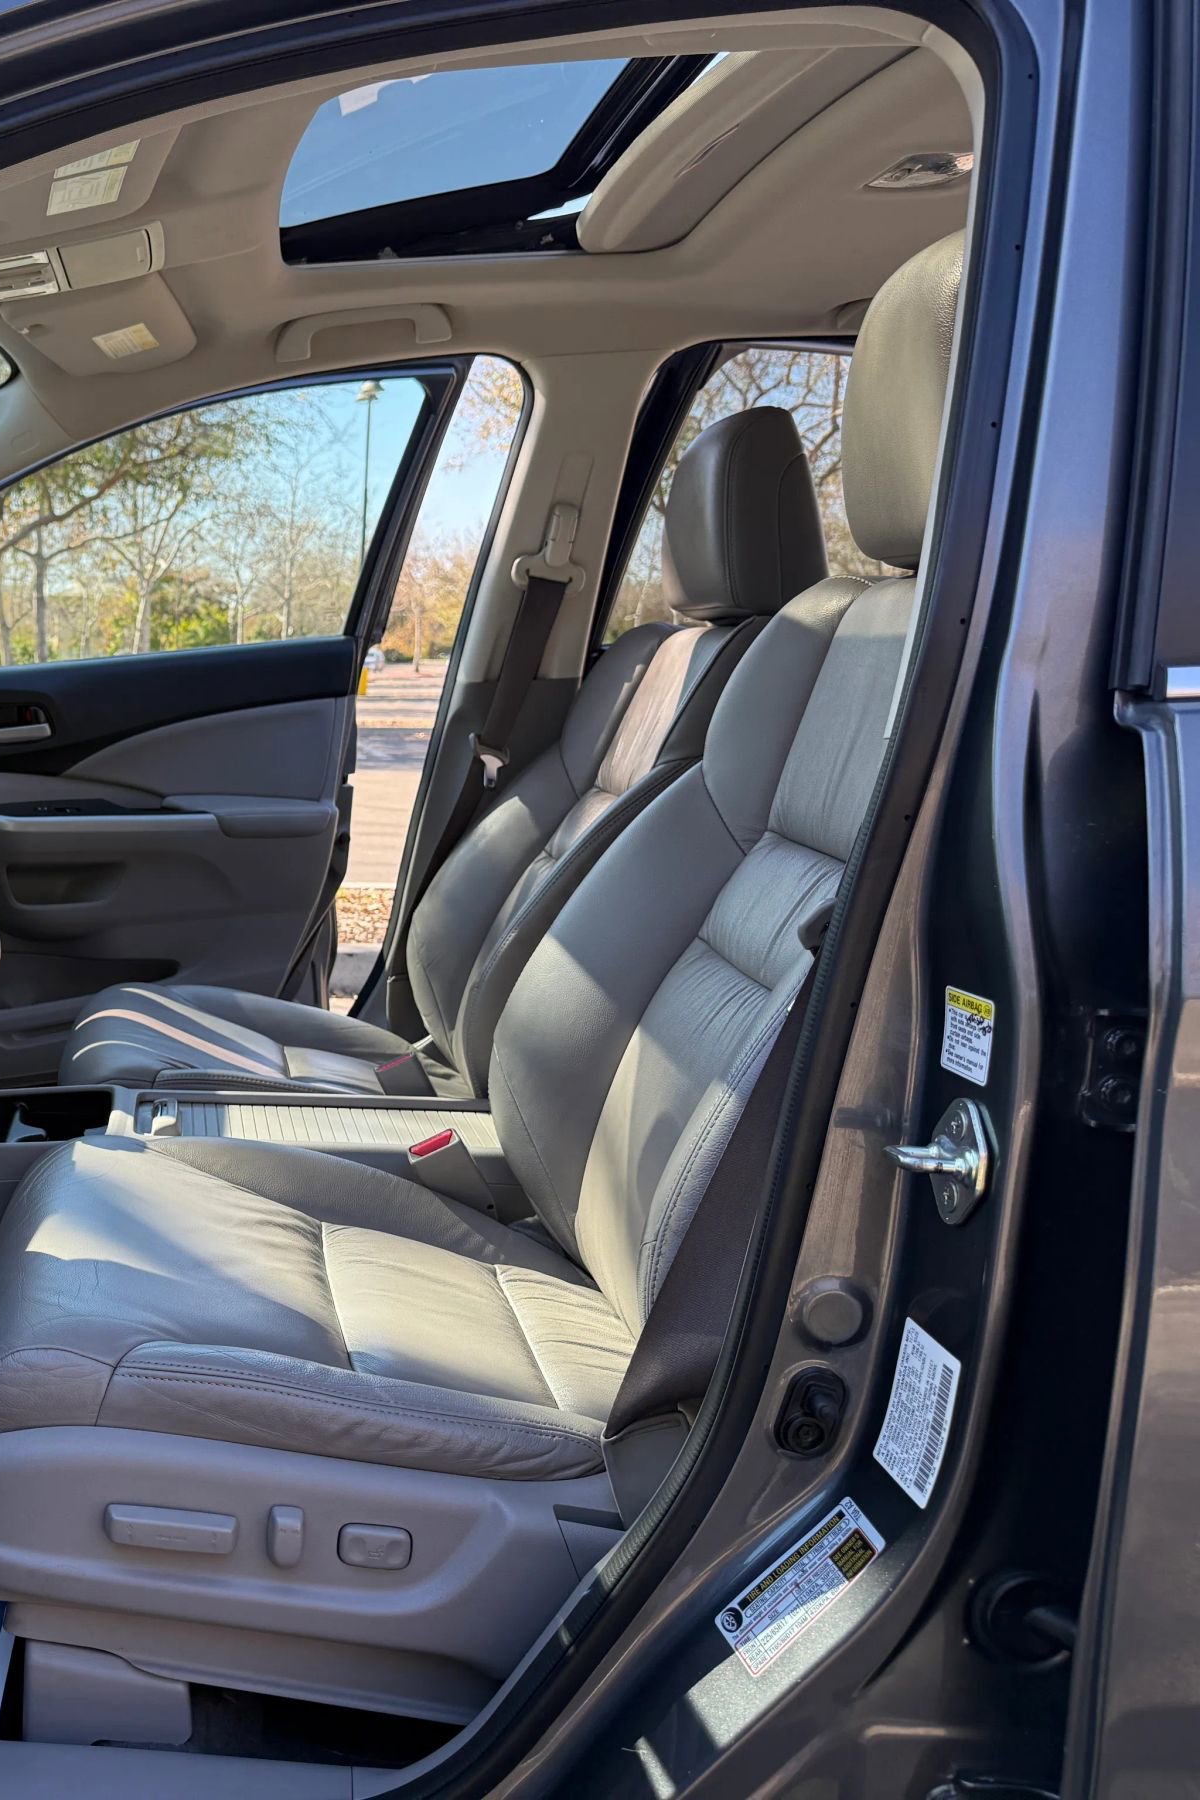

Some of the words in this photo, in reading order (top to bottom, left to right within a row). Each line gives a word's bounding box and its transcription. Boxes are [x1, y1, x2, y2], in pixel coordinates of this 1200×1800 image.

[948, 992, 961, 1005] SIDE
[962, 997, 983, 1014] AIRBAG
[844, 1499, 854, 1510] A2
[746, 1586, 762, 1603] TIRE
[759, 1575, 774, 1591] AND
[772, 1551, 800, 1579] LOADING
[798, 1514, 840, 1556] INFORMATION
[740, 1635, 752, 1648] TIRE
[767, 1608, 780, 1621] SIZE
[811, 1560, 831, 1580] PRESSURE
[749, 1594, 768, 1614] SEATING
[766, 1576, 787, 1597] CAPACITY
[743, 1640, 758, 1656] FRONT
[760, 1617, 789, 1646] 225/65R17
[748, 1647, 763, 1663] REAR
[753, 1654, 768, 1671] SPARE
